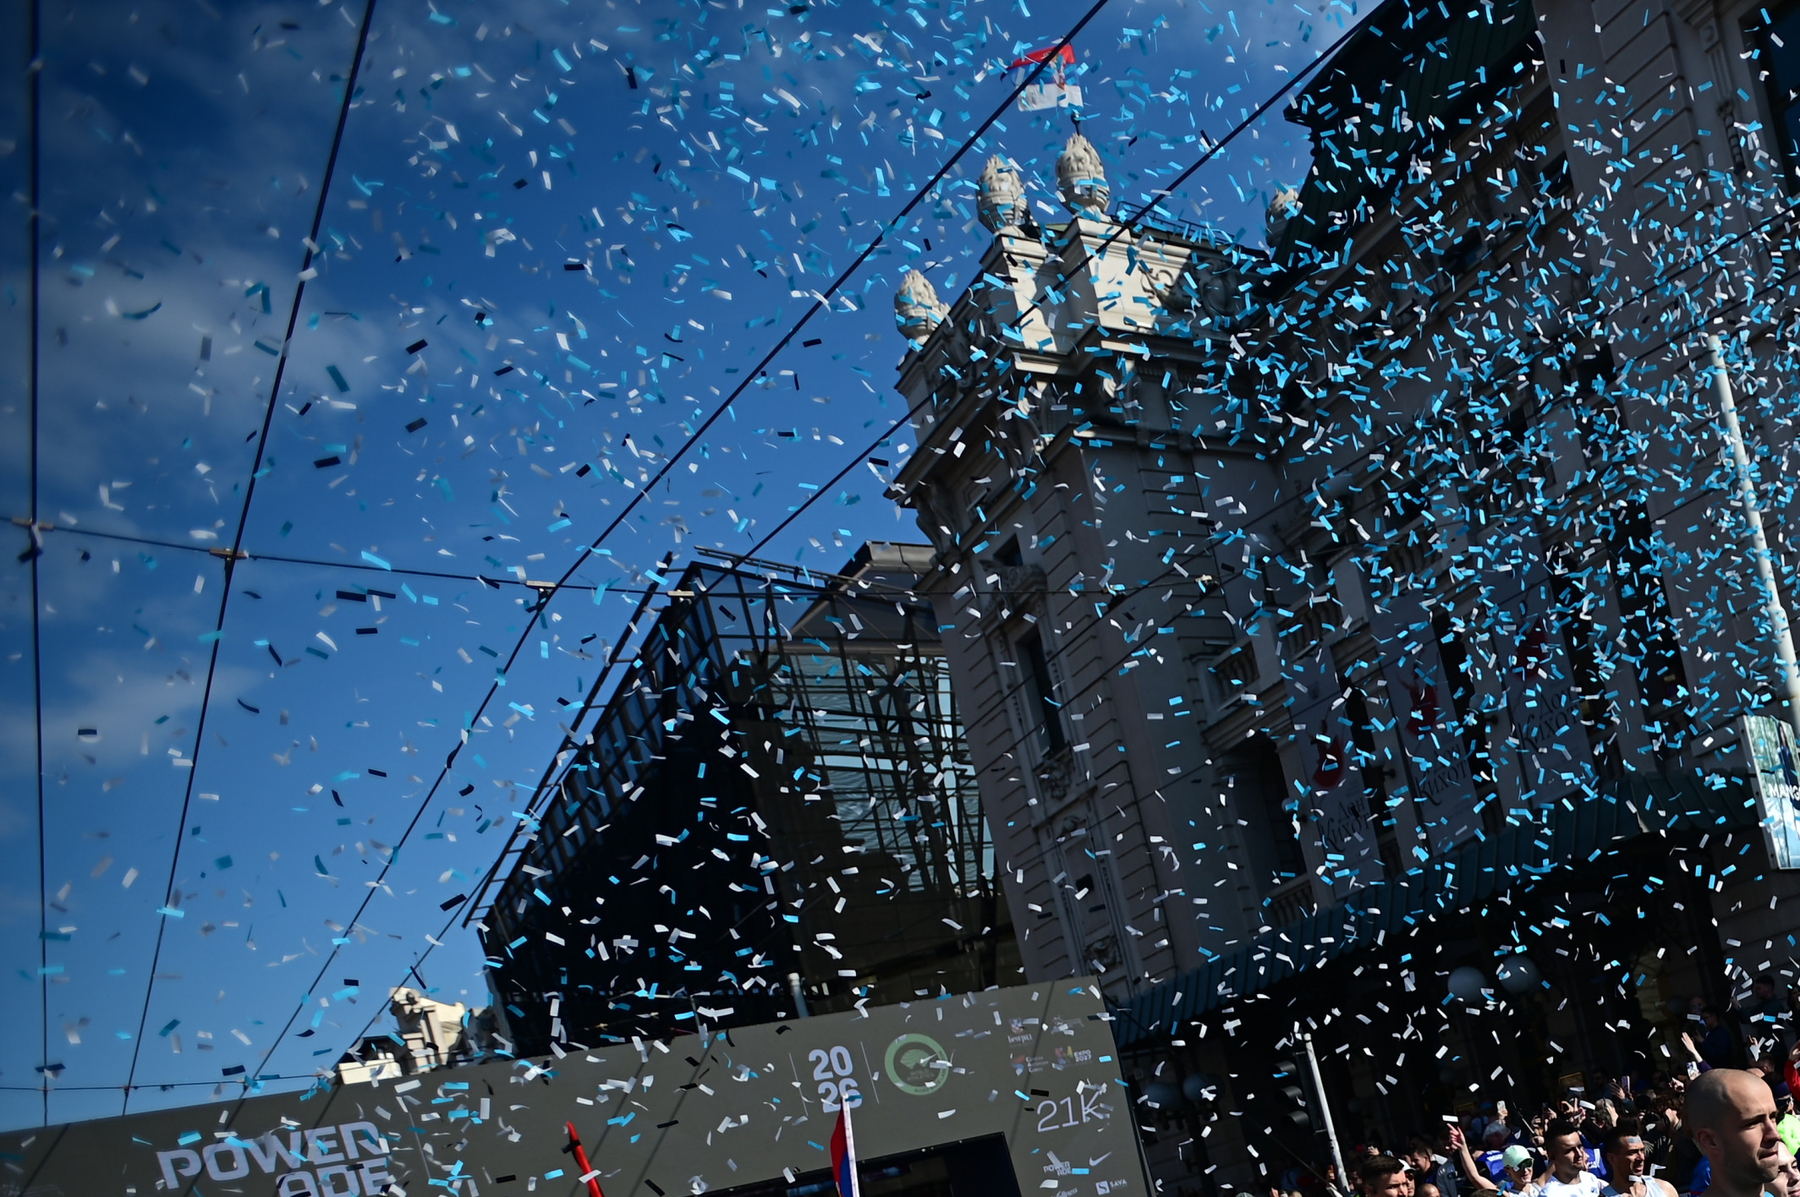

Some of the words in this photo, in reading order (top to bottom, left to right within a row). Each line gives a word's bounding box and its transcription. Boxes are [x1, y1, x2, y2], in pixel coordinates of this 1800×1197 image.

[808, 1045, 853, 1081] 20
[817, 1077, 863, 1113] 26
[1036, 1089, 1104, 1132] 21K
[156, 1121, 390, 1189] POWER
